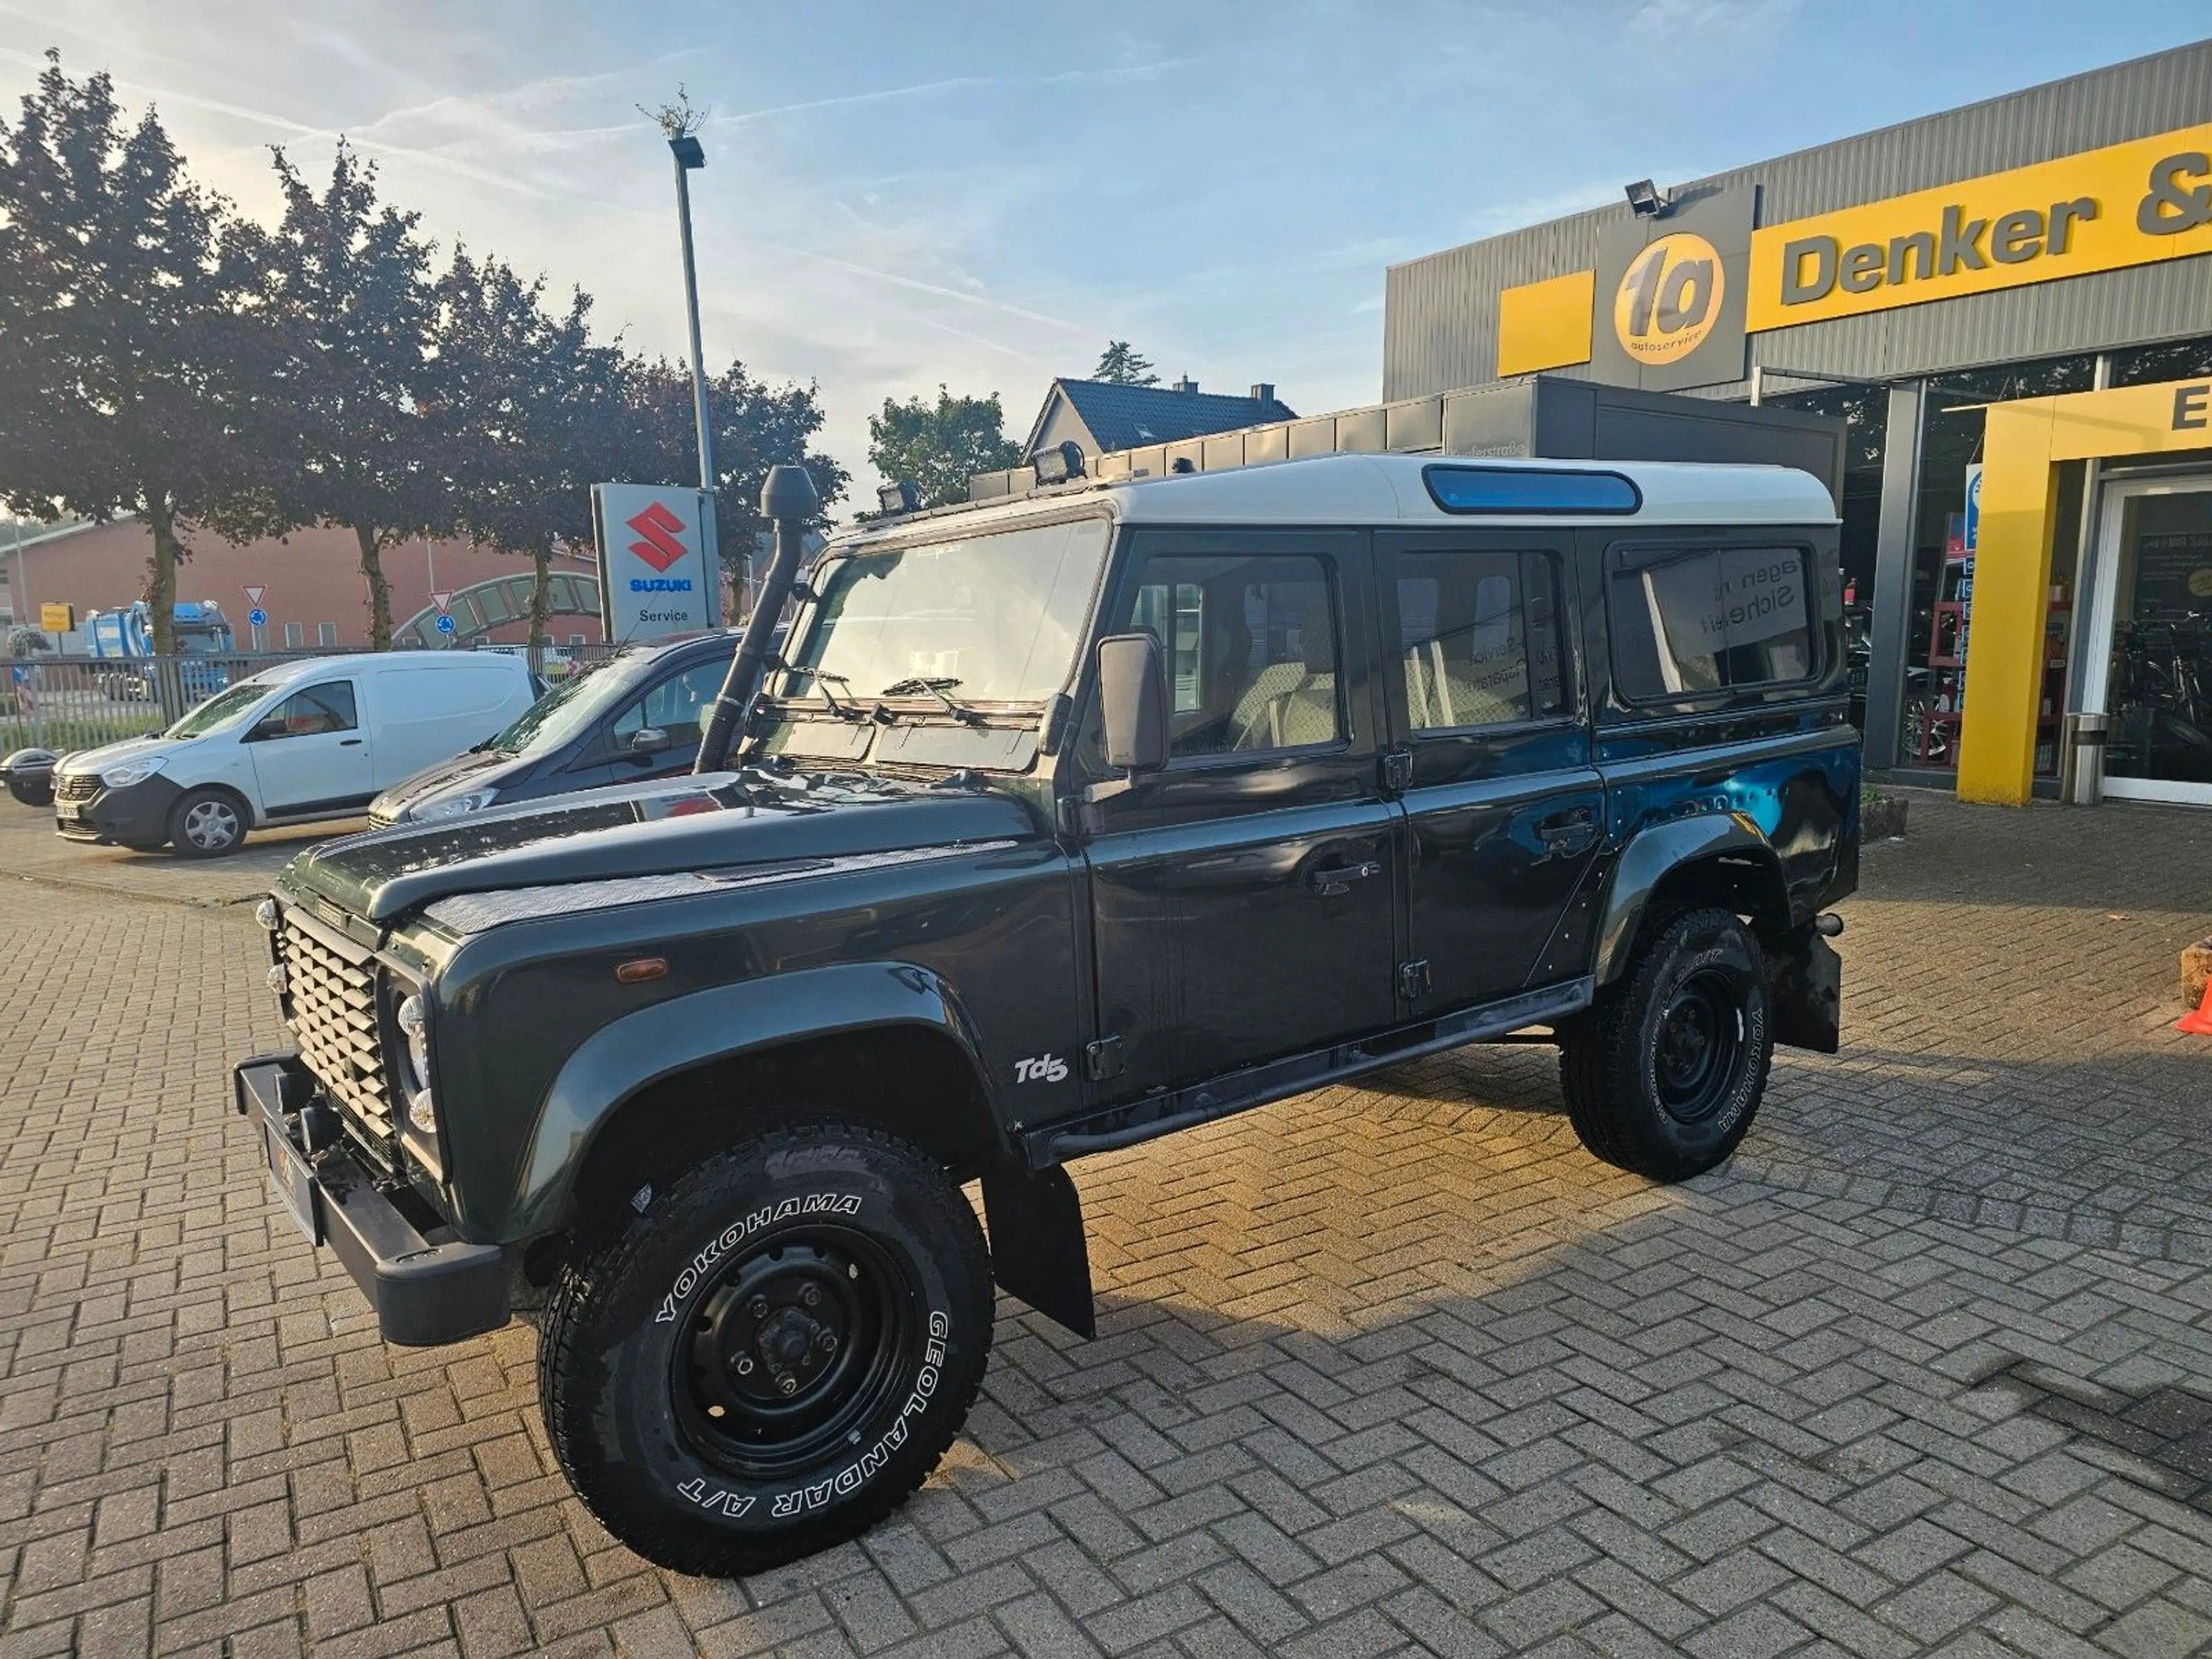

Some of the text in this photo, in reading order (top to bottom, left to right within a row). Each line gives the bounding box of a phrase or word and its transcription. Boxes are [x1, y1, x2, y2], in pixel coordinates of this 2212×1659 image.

[1781, 152, 2212, 306] Denker &
[1626, 247, 1713, 336] 1a
[1631, 330, 1702, 351] autoservice
[630, 579, 691, 592] SUZUKI
[639, 609, 688, 622] Service
[1015, 1054, 1068, 1083] Td5
[1718, 1007, 1763, 1132] YOKOHAMA
[656, 1194, 862, 1323] YOKOHAMA
[677, 1311, 949, 1518] GEOLANDAR A/T
